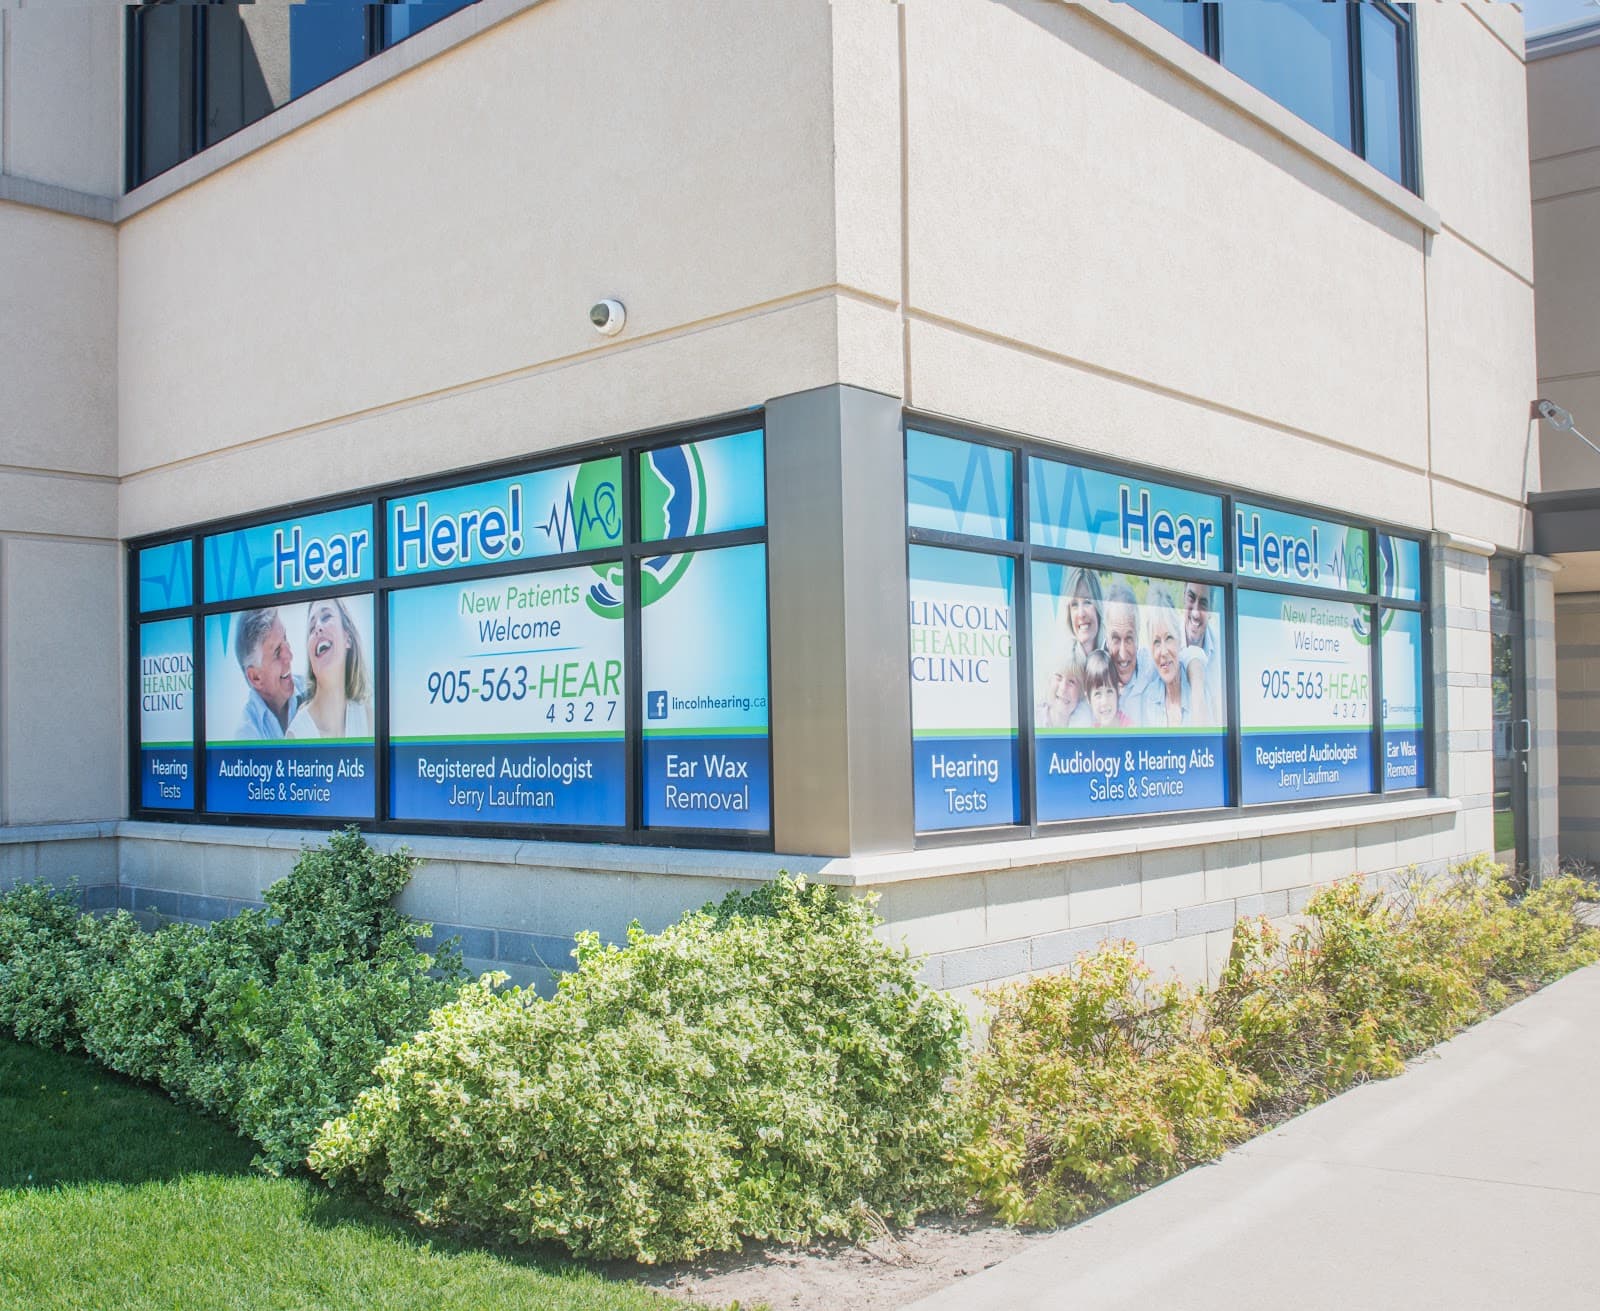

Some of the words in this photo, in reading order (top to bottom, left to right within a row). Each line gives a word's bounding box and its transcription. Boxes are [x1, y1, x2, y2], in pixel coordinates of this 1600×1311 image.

[274, 526, 368, 588] Hear
[395, 484, 523, 571] Here!
[1119, 484, 1215, 565] Hear
[1235, 510, 1319, 580] Here!
[461, 592, 501, 615] New
[506, 584, 580, 610] Patients
[910, 600, 1009, 631] LINCOLN
[1282, 604, 1307, 623] New
[1310, 608, 1349, 628] Patients
[479, 617, 561, 643] Welcome
[911, 628, 1013, 658] HEARING
[1294, 631, 1340, 653] Welcome
[143, 655, 194, 675] LINCOLN
[911, 656, 989, 683] CLINIC
[427, 659, 622, 705] 905-563-HEAR
[1261, 669, 1368, 700] 905-563-HEAR
[142, 693, 184, 712] CLINIC
[672, 695, 766, 712] lincolnhearing.ca
[1256, 745, 1307, 769] Registered
[1310, 743, 1358, 765] Audiologist
[1386, 741, 1399, 757] Ear
[1400, 740, 1416, 757] Wax
[152, 758, 188, 780] Hearing
[219, 759, 272, 782] Audiology
[275, 762, 285, 777] &
[287, 760, 334, 781] Hearing
[337, 758, 365, 778] Aids
[418, 757, 496, 783] Registered
[500, 756, 593, 784] Audiologist
[666, 754, 698, 778] Ear
[703, 754, 749, 778] Wax
[931, 753, 999, 783] Hearing
[1049, 751, 1121, 779] Audiology
[1124, 750, 1135, 771] &
[1138, 749, 1186, 774] Hearing
[1189, 748, 1214, 768] Aids
[1386, 759, 1417, 778] Removal
[158, 781, 181, 799] Tests
[1090, 777, 1124, 801] Sales
[1127, 777, 1138, 798] &
[1141, 776, 1184, 797] Service
[1278, 769, 1301, 792] Jerry
[1303, 766, 1340, 786] Laufman
[248, 783, 275, 800] Sales
[278, 785, 286, 800] &
[289, 783, 331, 802] Service
[449, 784, 485, 812] Jerry
[489, 784, 555, 807] Laufman
[665, 784, 749, 810] Removal
[945, 788, 987, 812] Tests
